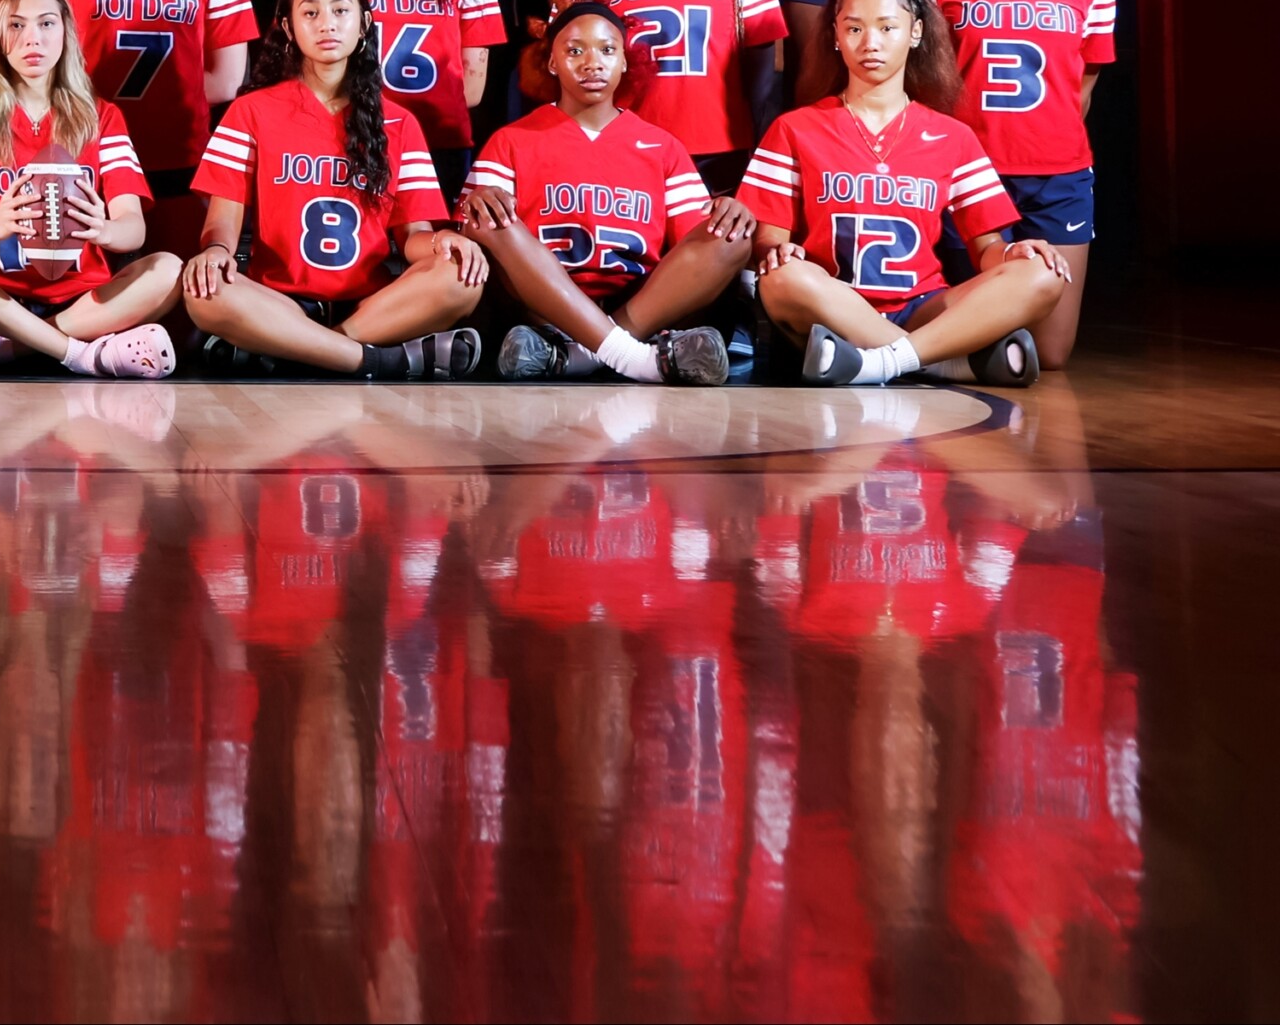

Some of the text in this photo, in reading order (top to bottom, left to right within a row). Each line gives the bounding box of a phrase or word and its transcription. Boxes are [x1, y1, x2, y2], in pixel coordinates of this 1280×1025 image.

[115, 30, 174, 100] 7
[623, 4, 712, 77] 21
[981, 38, 1047, 113] 3
[299, 196, 362, 271] 8
[831, 212, 922, 293] 12
